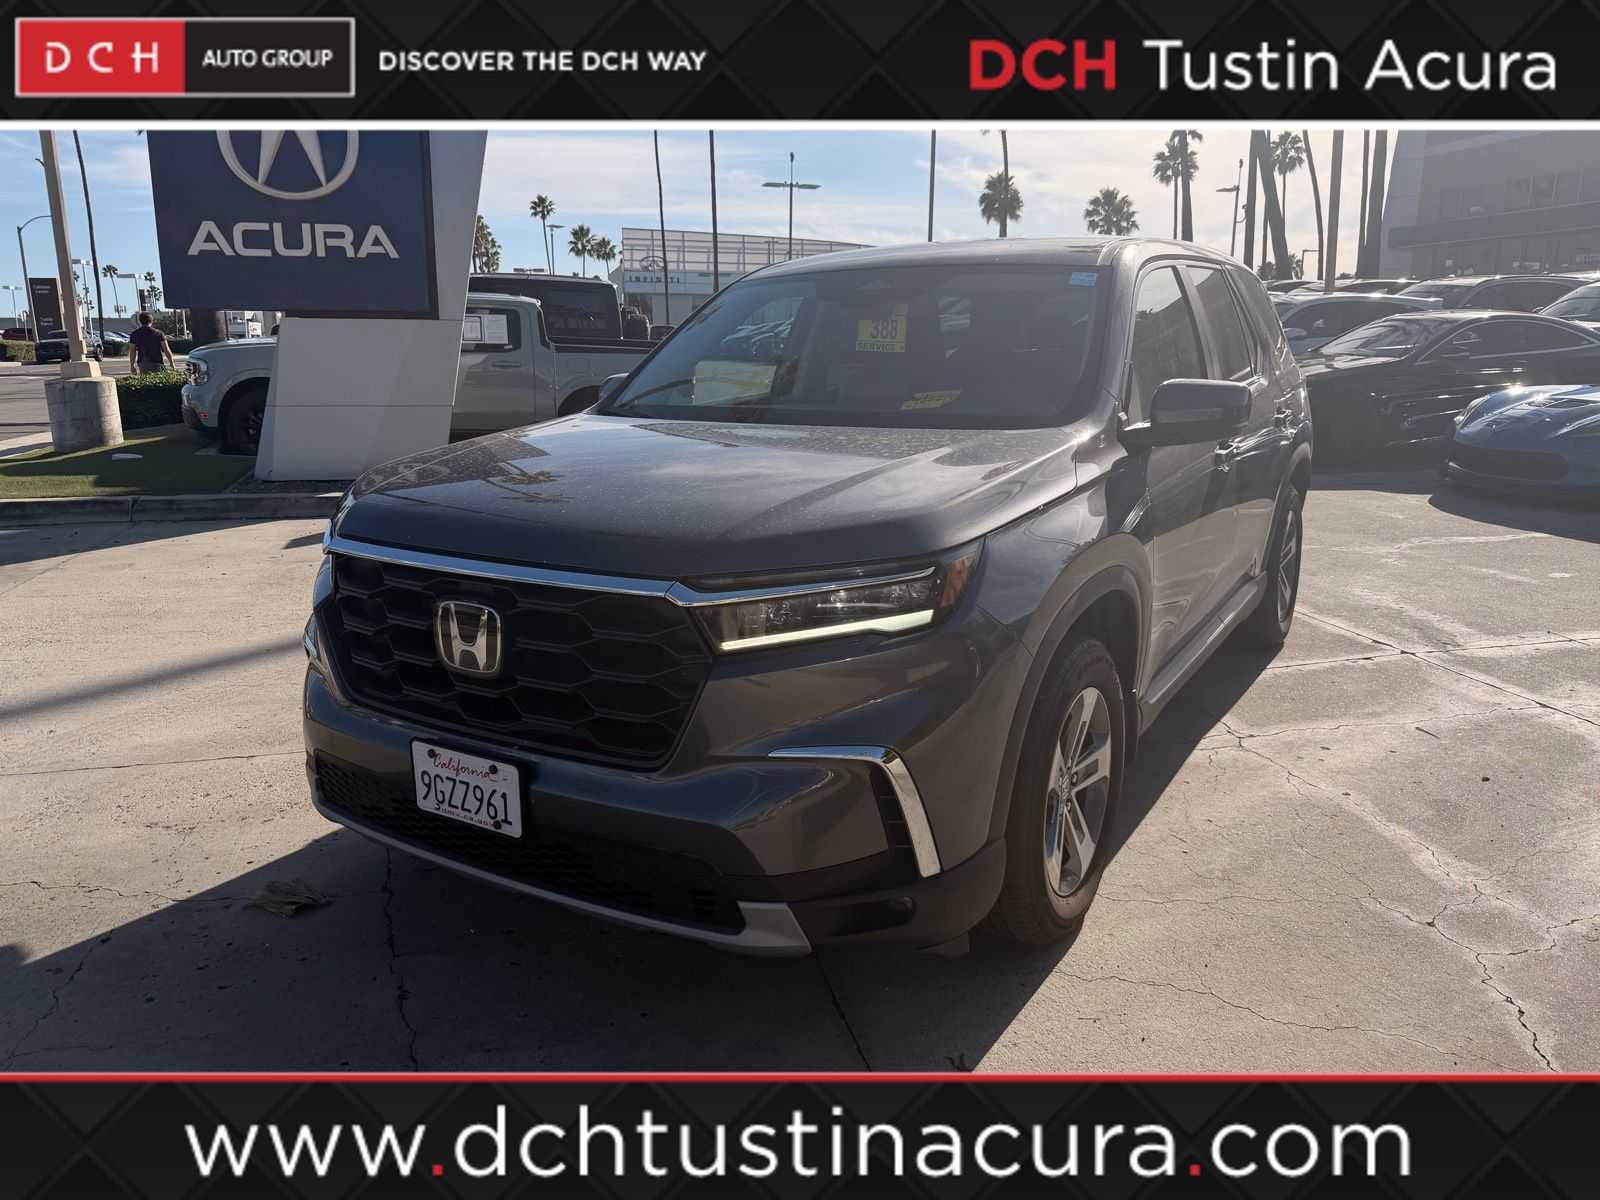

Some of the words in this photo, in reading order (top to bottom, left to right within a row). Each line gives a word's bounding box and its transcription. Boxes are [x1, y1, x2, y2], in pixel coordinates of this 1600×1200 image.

[188, 220, 401, 259] ACURA
[628, 274, 681, 284] INFINTI
[433, 752, 491, 778] California
[420, 770, 513, 826] 9GZZ961
